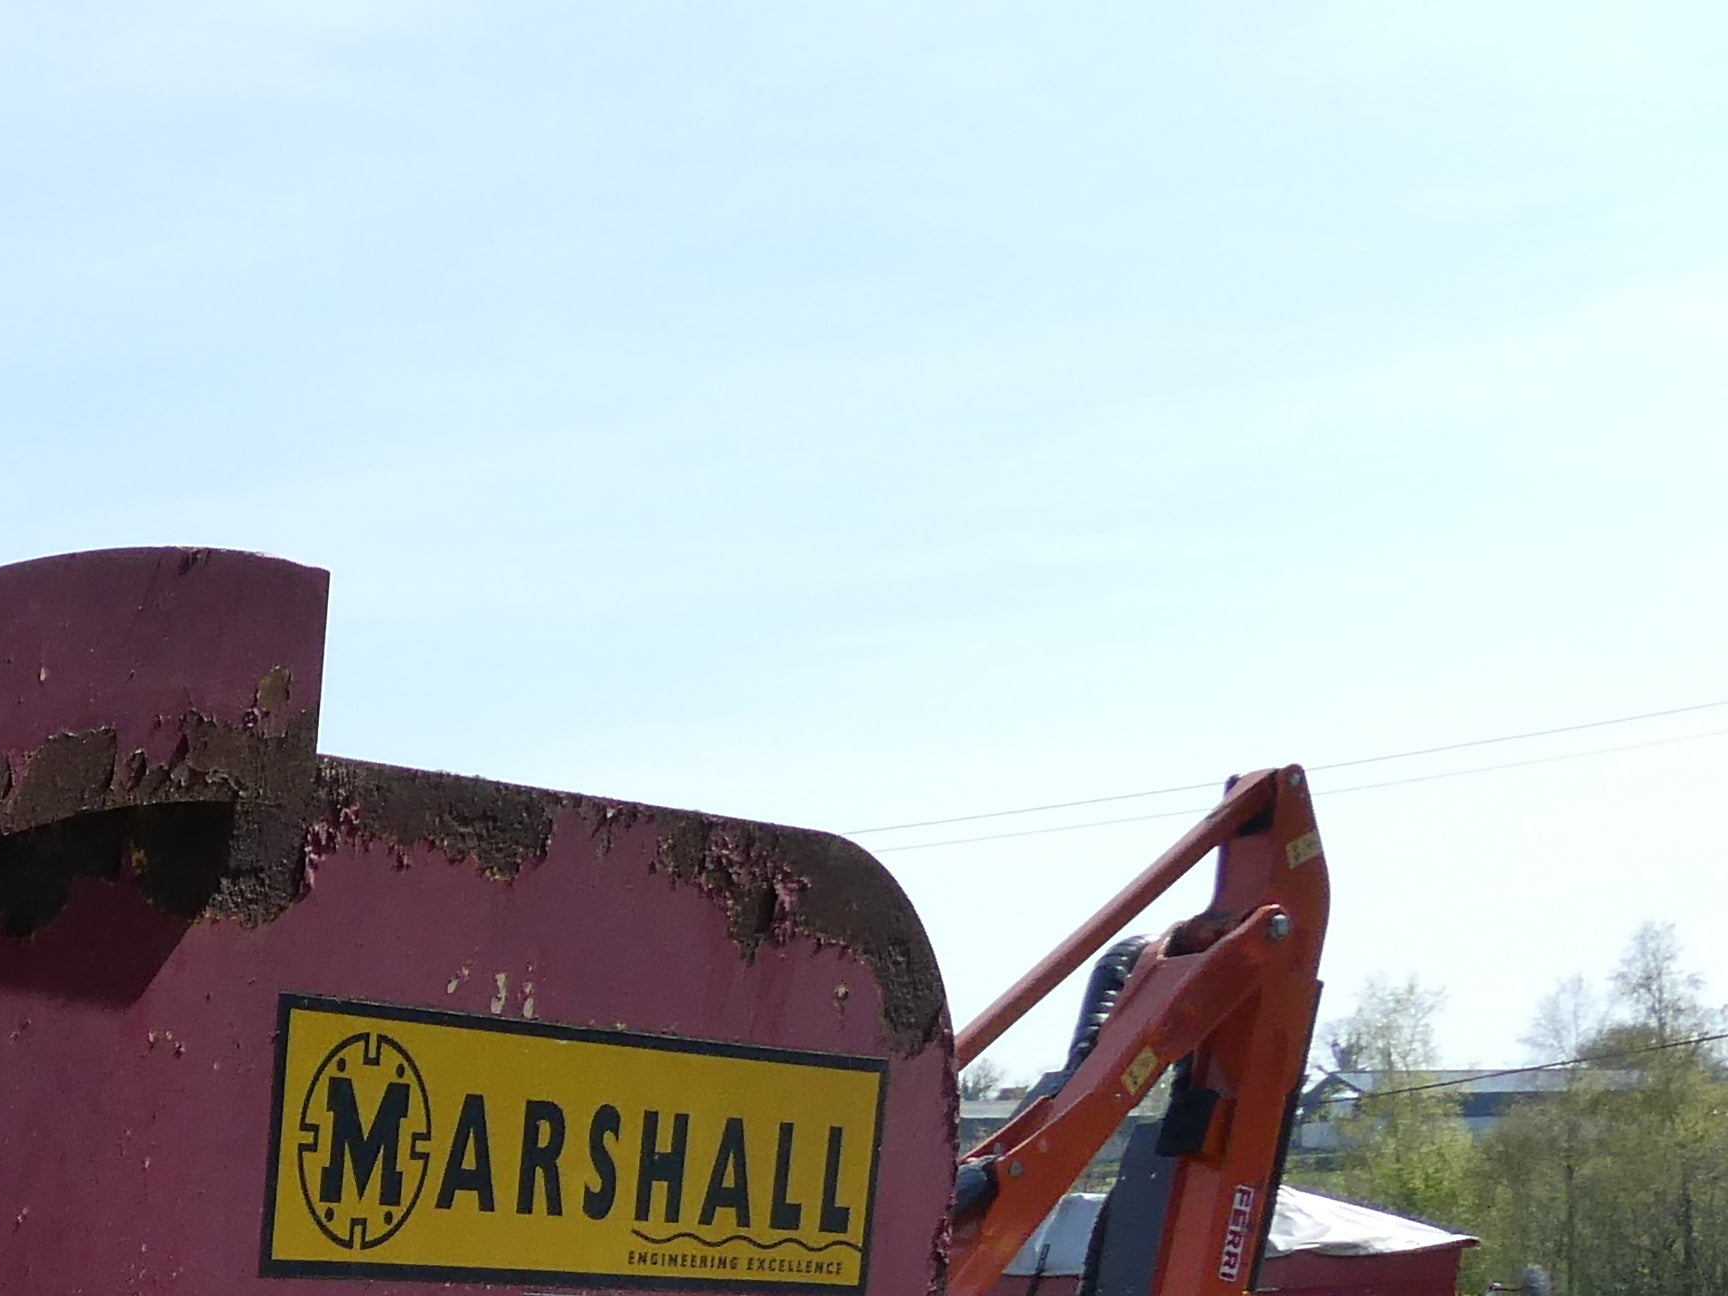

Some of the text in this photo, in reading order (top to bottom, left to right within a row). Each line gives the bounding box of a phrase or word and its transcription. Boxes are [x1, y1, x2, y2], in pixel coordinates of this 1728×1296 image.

[319, 1076, 851, 1235] MARSHALL
[627, 1250, 843, 1275] ENGINEERING EXCELLENCE
[1220, 1187, 1253, 1280] FERRI
